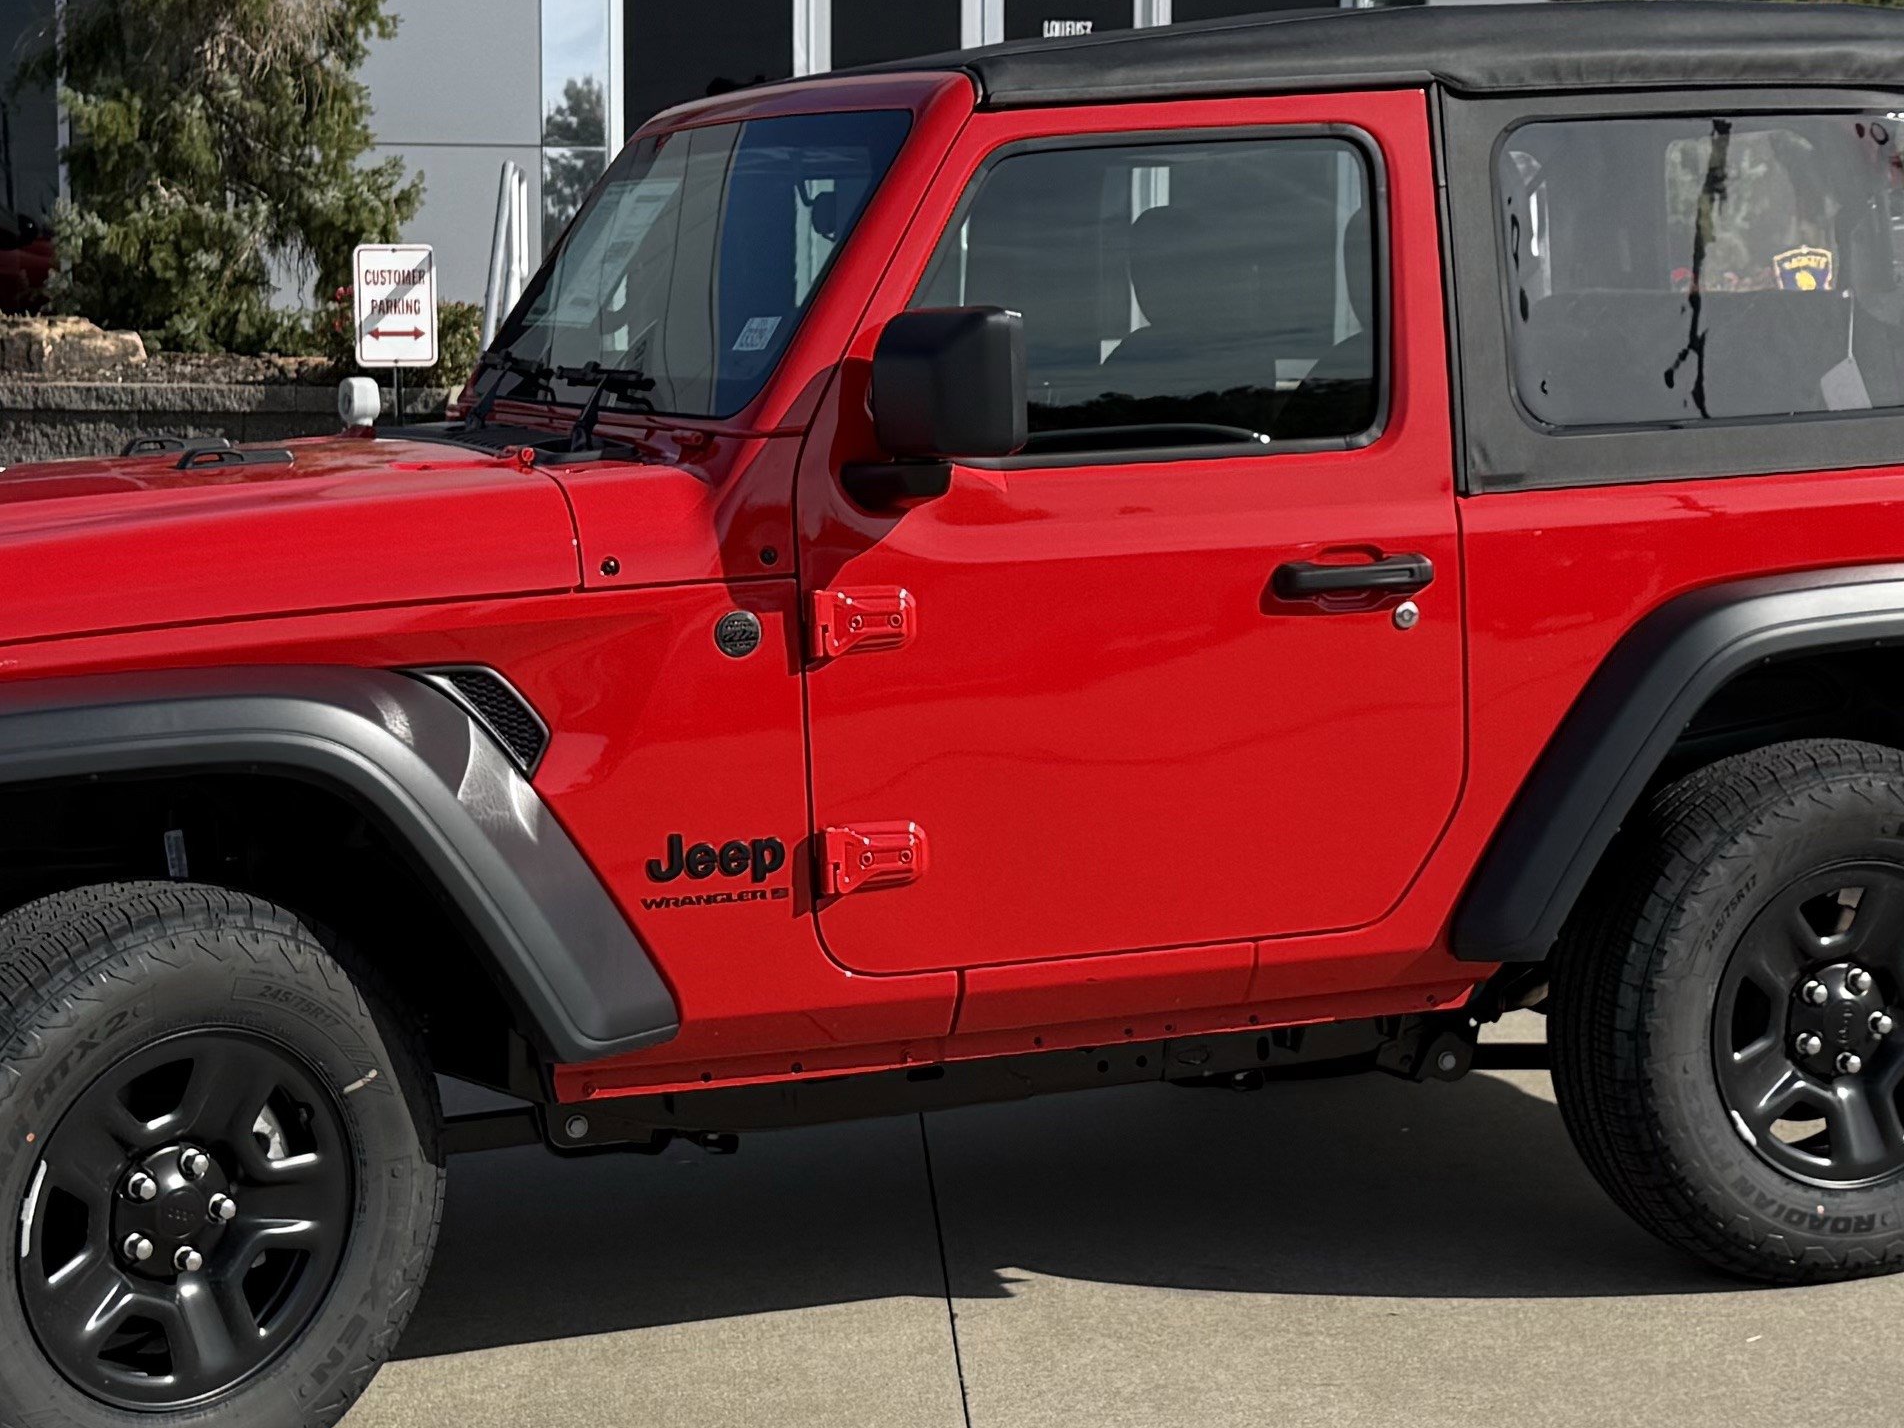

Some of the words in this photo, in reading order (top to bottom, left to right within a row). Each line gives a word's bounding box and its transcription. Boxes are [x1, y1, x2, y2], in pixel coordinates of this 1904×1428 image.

[364, 269, 425, 286] CUSTOMER
[370, 299, 420, 315] PARKING
[646, 833, 786, 883] Jeep
[641, 889, 768, 910] WRANGLER
[258, 983, 342, 1027] 245/75R17
